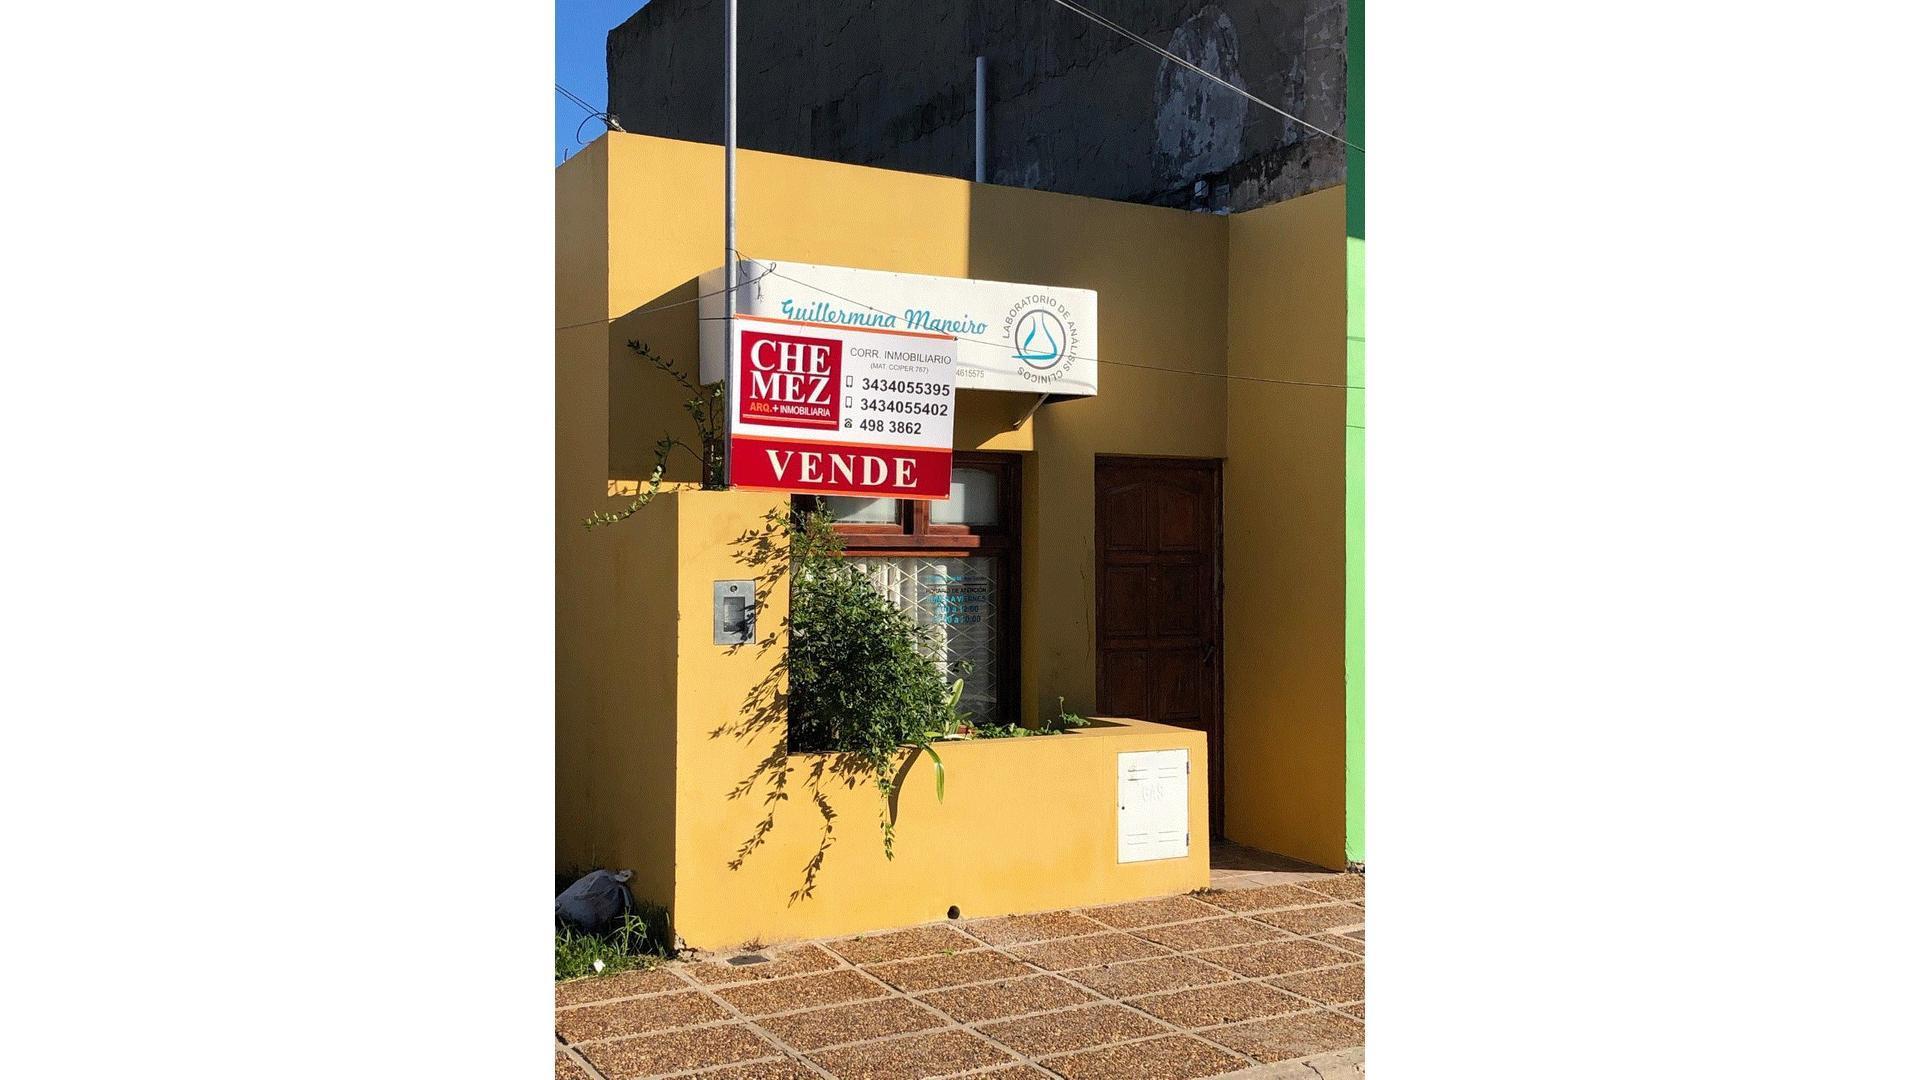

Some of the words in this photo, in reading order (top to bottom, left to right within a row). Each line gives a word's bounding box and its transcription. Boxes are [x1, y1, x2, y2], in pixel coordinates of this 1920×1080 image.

[781, 299, 897, 328] Guillermina
[904, 308, 989, 335] Maneiro
[1002, 294, 1057, 339] LABORATORIO
[1057, 304, 1071, 320] DE
[750, 339, 831, 376] CHE
[850, 347, 881, 359] CORR.
[884, 350, 952, 365] INMOBILIARIO
[749, 370, 831, 405] MEZ
[862, 378, 950, 397] 3434055395
[780, 405, 831, 417] INMOBILIARIA
[860, 398, 948, 417] 3434055402
[859, 419, 884, 433] 498
[888, 421, 922, 435] 3862
[765, 449, 918, 488] VENDE
